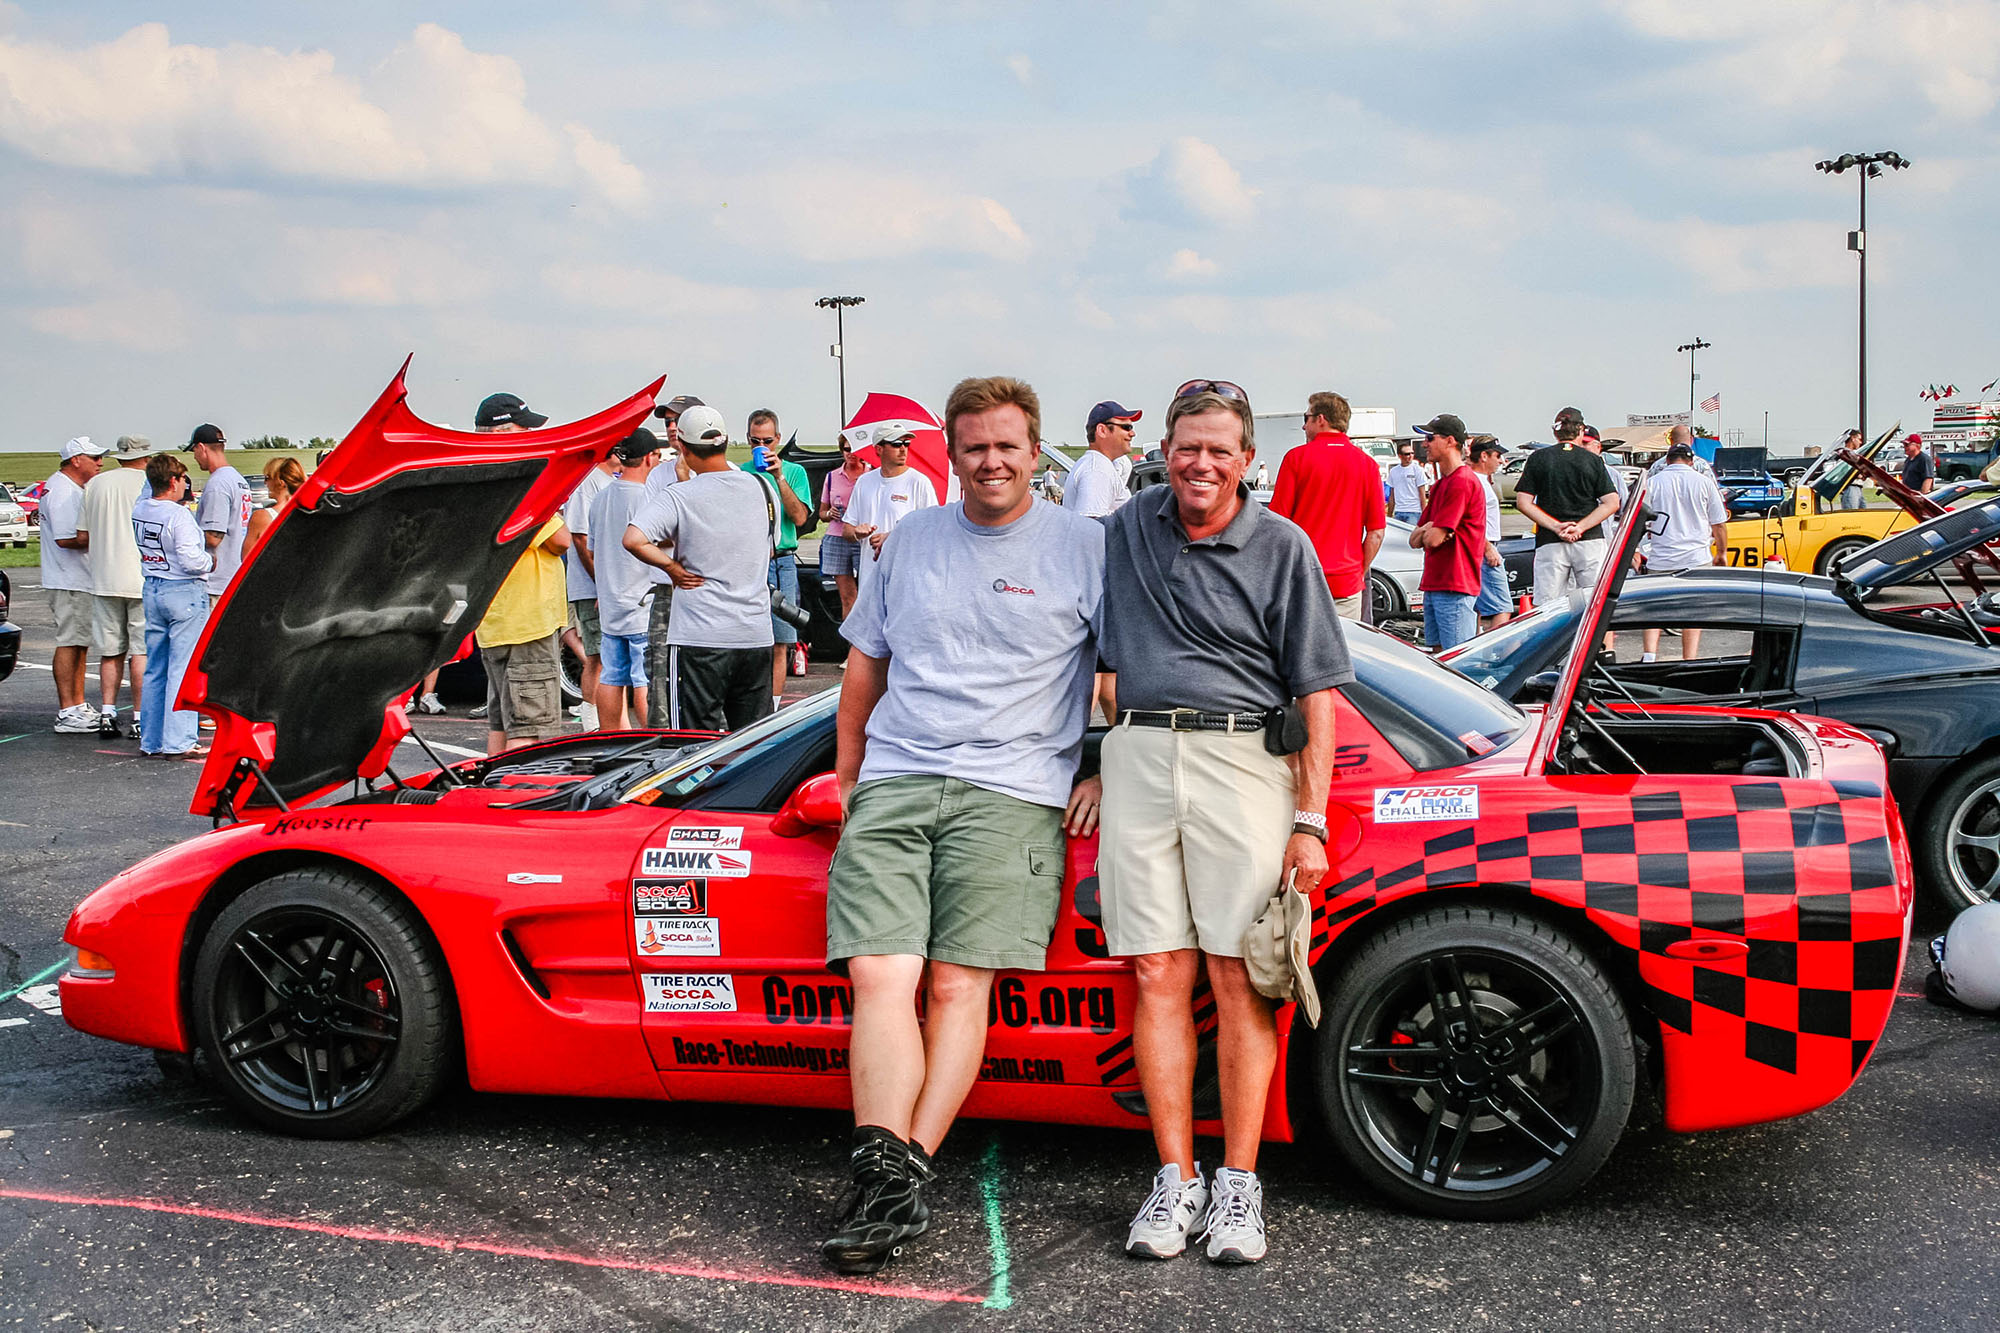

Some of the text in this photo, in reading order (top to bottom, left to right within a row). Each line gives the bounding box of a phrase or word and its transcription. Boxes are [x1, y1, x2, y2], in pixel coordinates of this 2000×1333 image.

[1004, 585, 1035, 595] SCCA
[1379, 804, 1473, 817] CHALLENGE
[672, 830, 720, 839] CHASE
[645, 851, 713, 869] HAWK
[636, 885, 691, 898] SCCA
[637, 901, 691, 910] SOLO
[658, 920, 712, 933] TIRE RACK
[661, 934, 694, 942] SCCA
[650, 976, 730, 991] TIRE RACK
[661, 989, 715, 999] SCCA
[648, 1001, 732, 1010] National Solo
[672, 1036, 850, 1072] Race-Technology.co
